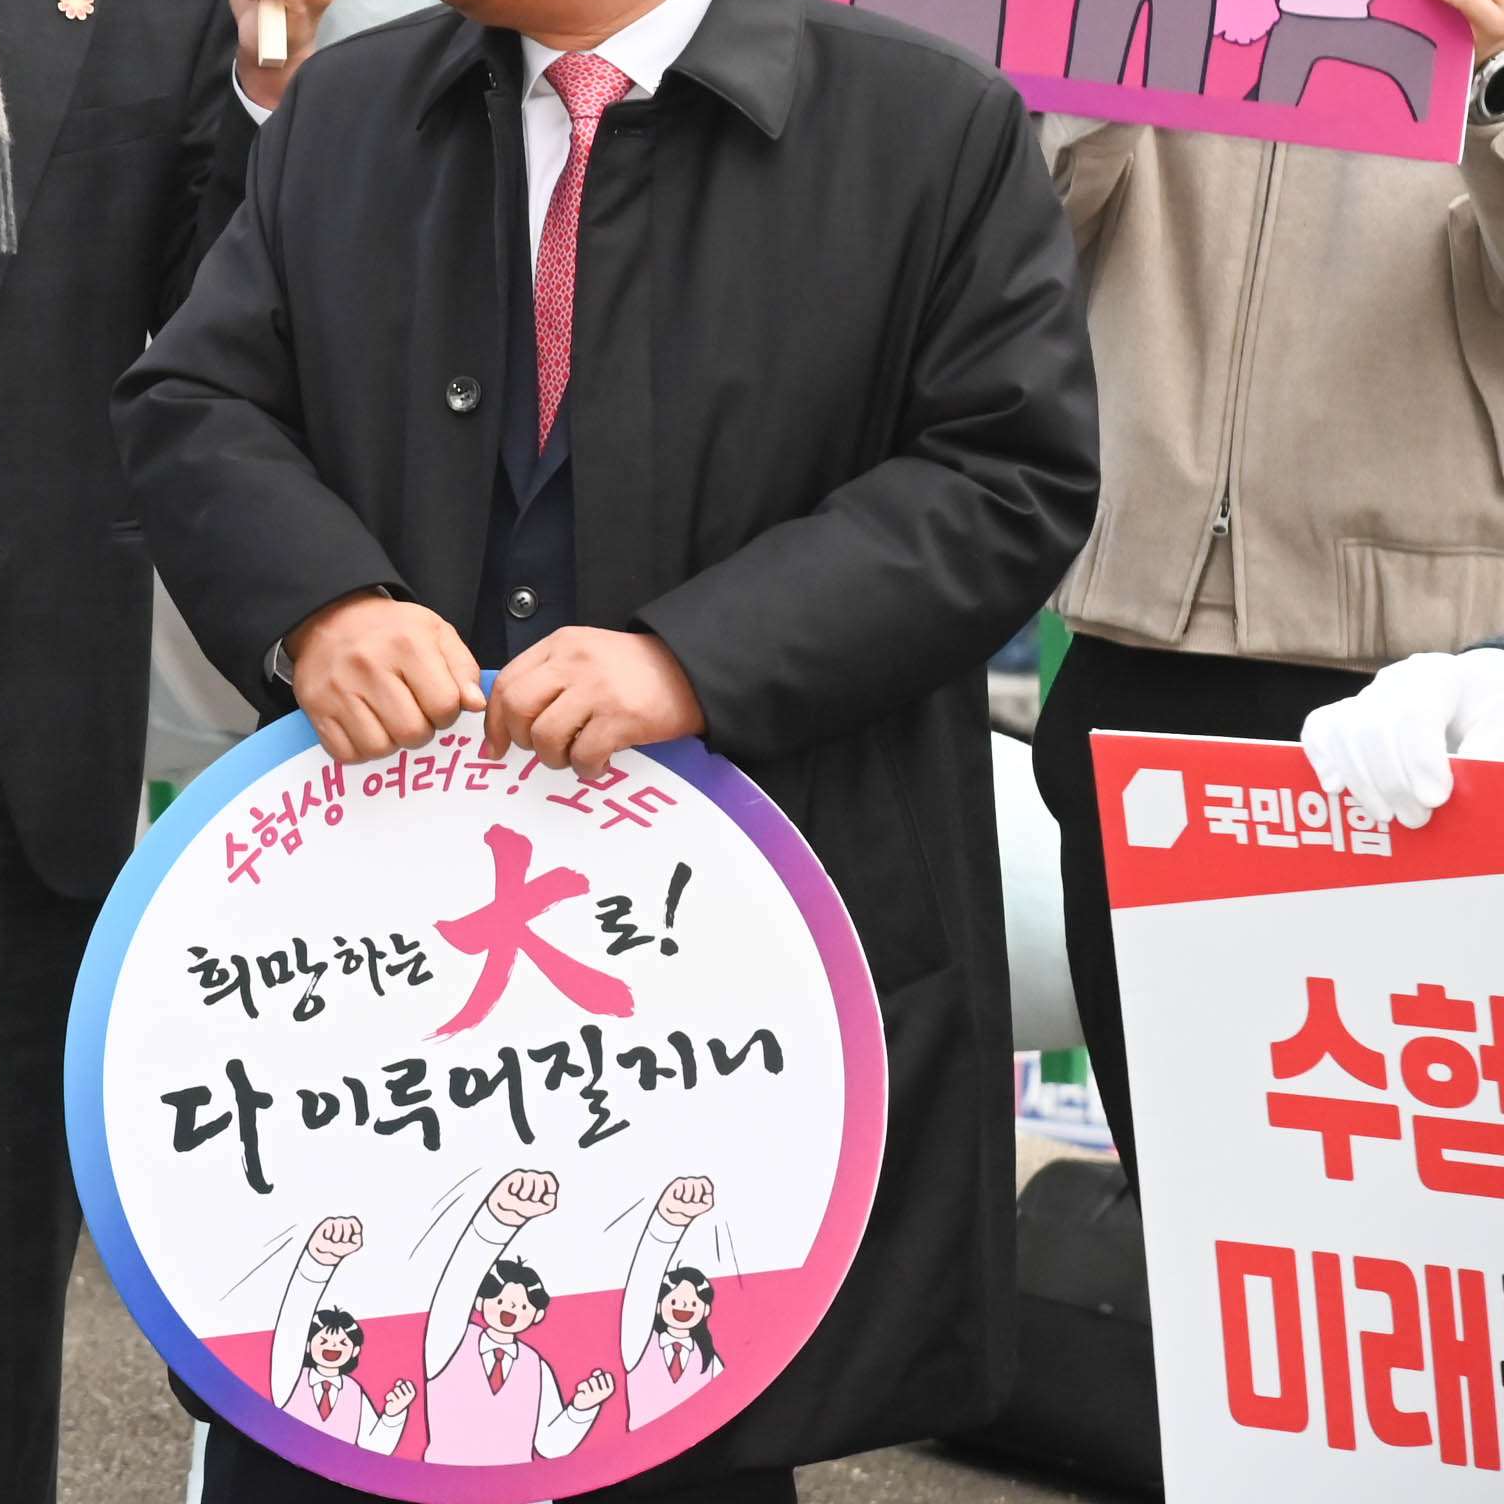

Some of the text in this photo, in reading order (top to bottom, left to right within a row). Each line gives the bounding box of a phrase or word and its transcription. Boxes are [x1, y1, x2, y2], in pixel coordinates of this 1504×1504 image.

[224, 762, 347, 885] 수험생
[187, 933, 434, 1022] 희망하는
[160, 1023, 784, 1195] 다 이루어질지니
